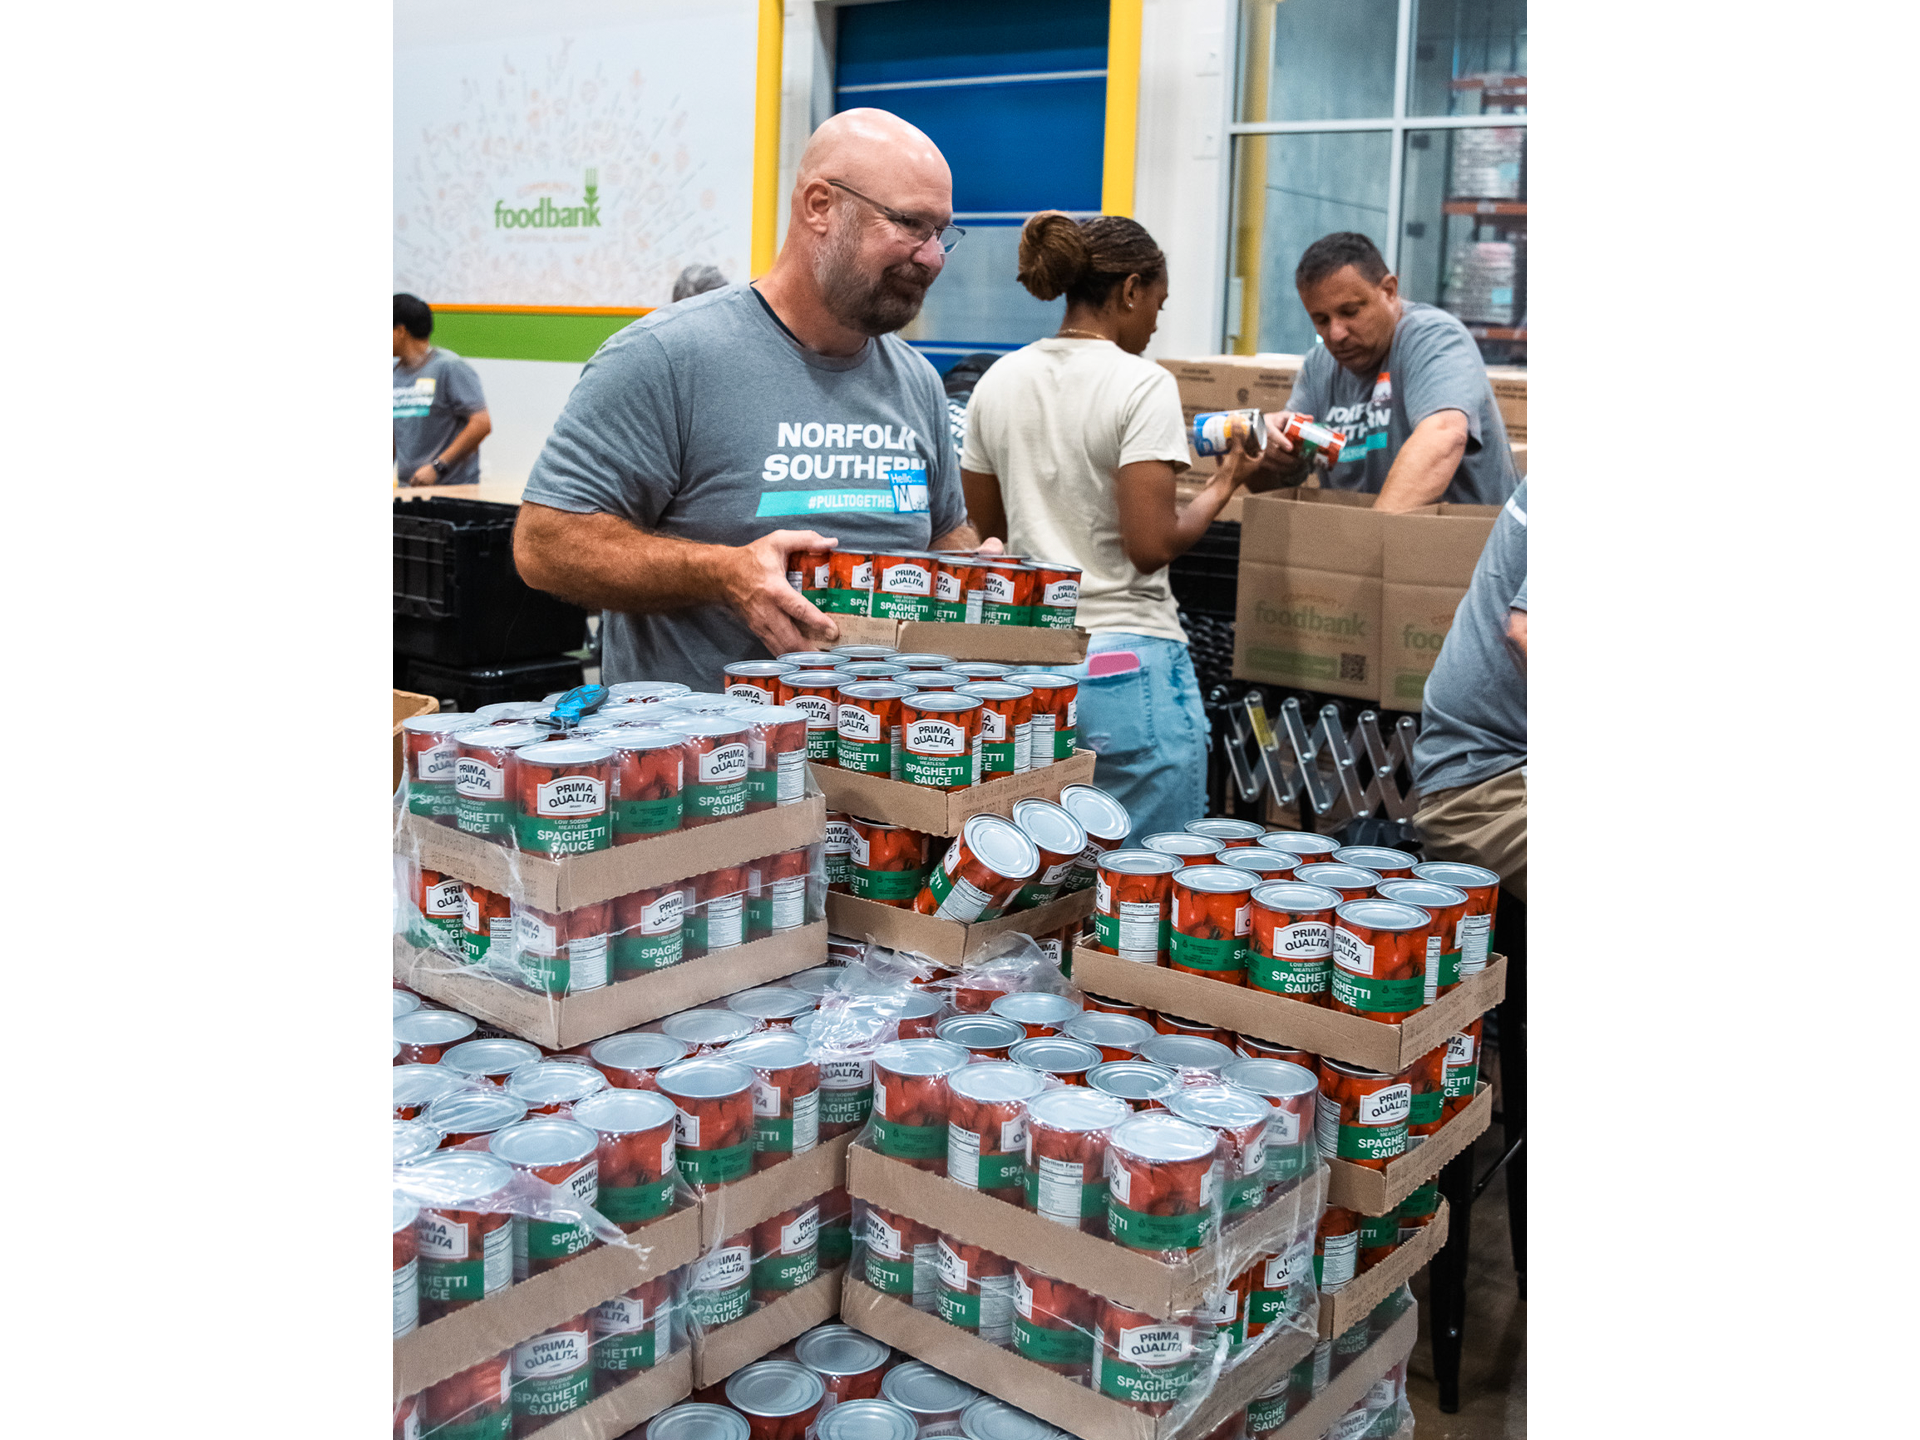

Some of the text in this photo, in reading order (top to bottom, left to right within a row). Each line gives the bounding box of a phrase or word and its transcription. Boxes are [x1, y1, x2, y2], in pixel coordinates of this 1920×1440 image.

[494, 197, 601, 229] foodbank
[777, 422, 917, 451] NORFOLK
[808, 494, 896, 509] #PULLTOGETHE
[895, 569, 922, 579] PRIMA
[889, 578, 924, 588] QUALITA
[985, 577, 1003, 588] IMA
[985, 585, 1005, 597] ALITA
[880, 602, 929, 613] SPAGHETTI
[888, 611, 920, 621] SAUCE
[983, 612, 1011, 621] HETTI
[1255, 602, 1367, 637] foodbank
[732, 690, 760, 700] PRIMA
[796, 701, 827, 711] PRIMA
[842, 711, 866, 722] PRIMA
[918, 726, 951, 735] PRIMA
[913, 732, 955, 746] QUALITA
[717, 749, 744, 762] PRIMA
[807, 750, 829, 759] UCE
[459, 764, 486, 777] PRIMA
[905, 763, 963, 776] SPAGHETTI
[914, 775, 952, 786] SAUCE
[555, 782, 593, 795] PRIMA
[549, 793, 597, 808] QUALITA
[712, 801, 744, 816] SAUCE
[457, 819, 490, 833] SAUCE
[825, 827, 849, 836] RIMA
[537, 826, 605, 841] SPAGHETTI
[826, 835, 851, 844] ALITA
[551, 840, 594, 852] SAUCE
[1081, 853, 1097, 864] LITA
[829, 875, 850, 884] UCE
[1066, 873, 1092, 884] HETTI
[443, 885, 463, 896] PRI
[1292, 929, 1327, 939] PRIMA
[1285, 939, 1330, 951] QUALITA
[1272, 970, 1332, 983] SPAGHETT
[1285, 982, 1326, 993] SAUCE
[1379, 1089, 1408, 1104] PRIMA
[819, 1112, 861, 1123] SAUCE
[1371, 1143, 1405, 1159] SAUCE
[420, 1233, 453, 1249] ALITA
[707, 1253, 742, 1268] PRIMA
[424, 1276, 467, 1287] HETTI
[702, 1308, 743, 1326] SAUCE
[1140, 1332, 1180, 1342] PRIMA
[532, 1338, 574, 1355] PRIMA
[1131, 1341, 1182, 1356] QUALITA
[513, 1378, 588, 1404] SPAGHETTI
[1131, 1388, 1177, 1403] SAUCE
[529, 1397, 577, 1416] SAUCE
